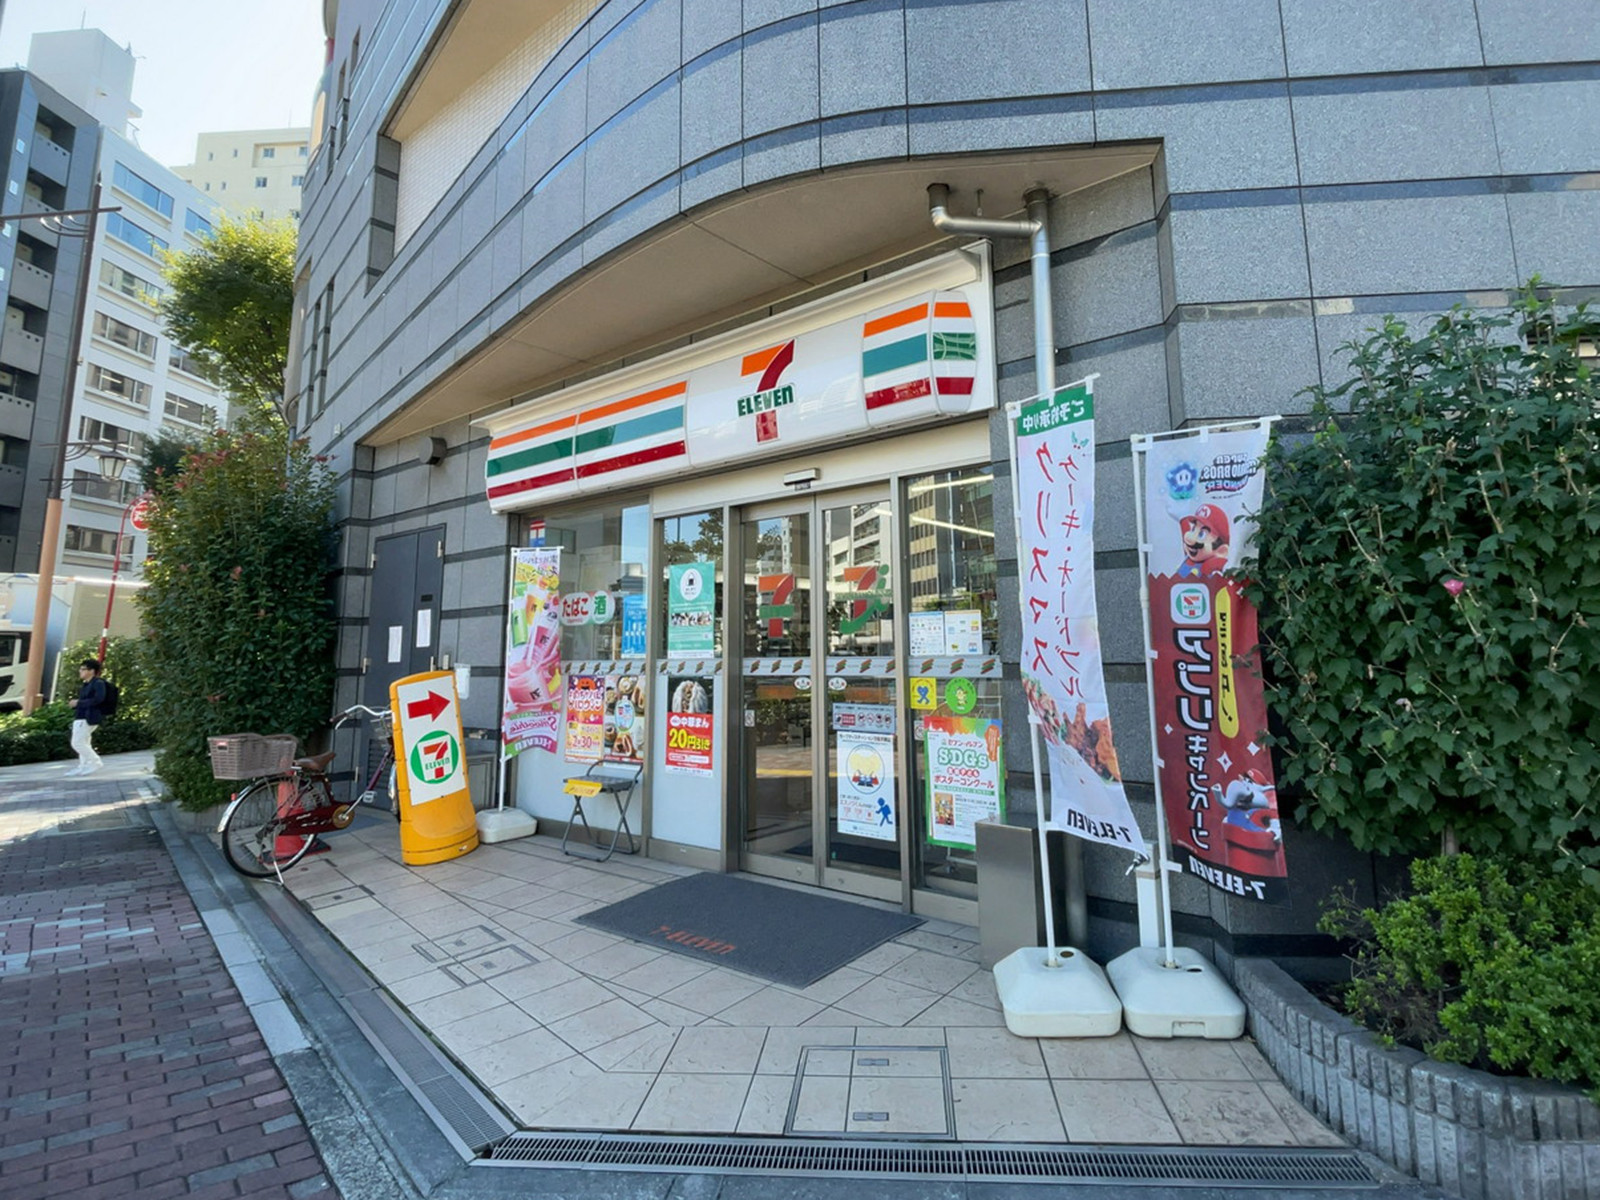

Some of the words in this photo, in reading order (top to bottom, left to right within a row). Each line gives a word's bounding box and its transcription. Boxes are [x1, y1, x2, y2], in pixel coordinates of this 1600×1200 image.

[562, 597, 589, 617] たばこ
[594, 595, 607, 615] 酒
[937, 747, 989, 769] SDGs
